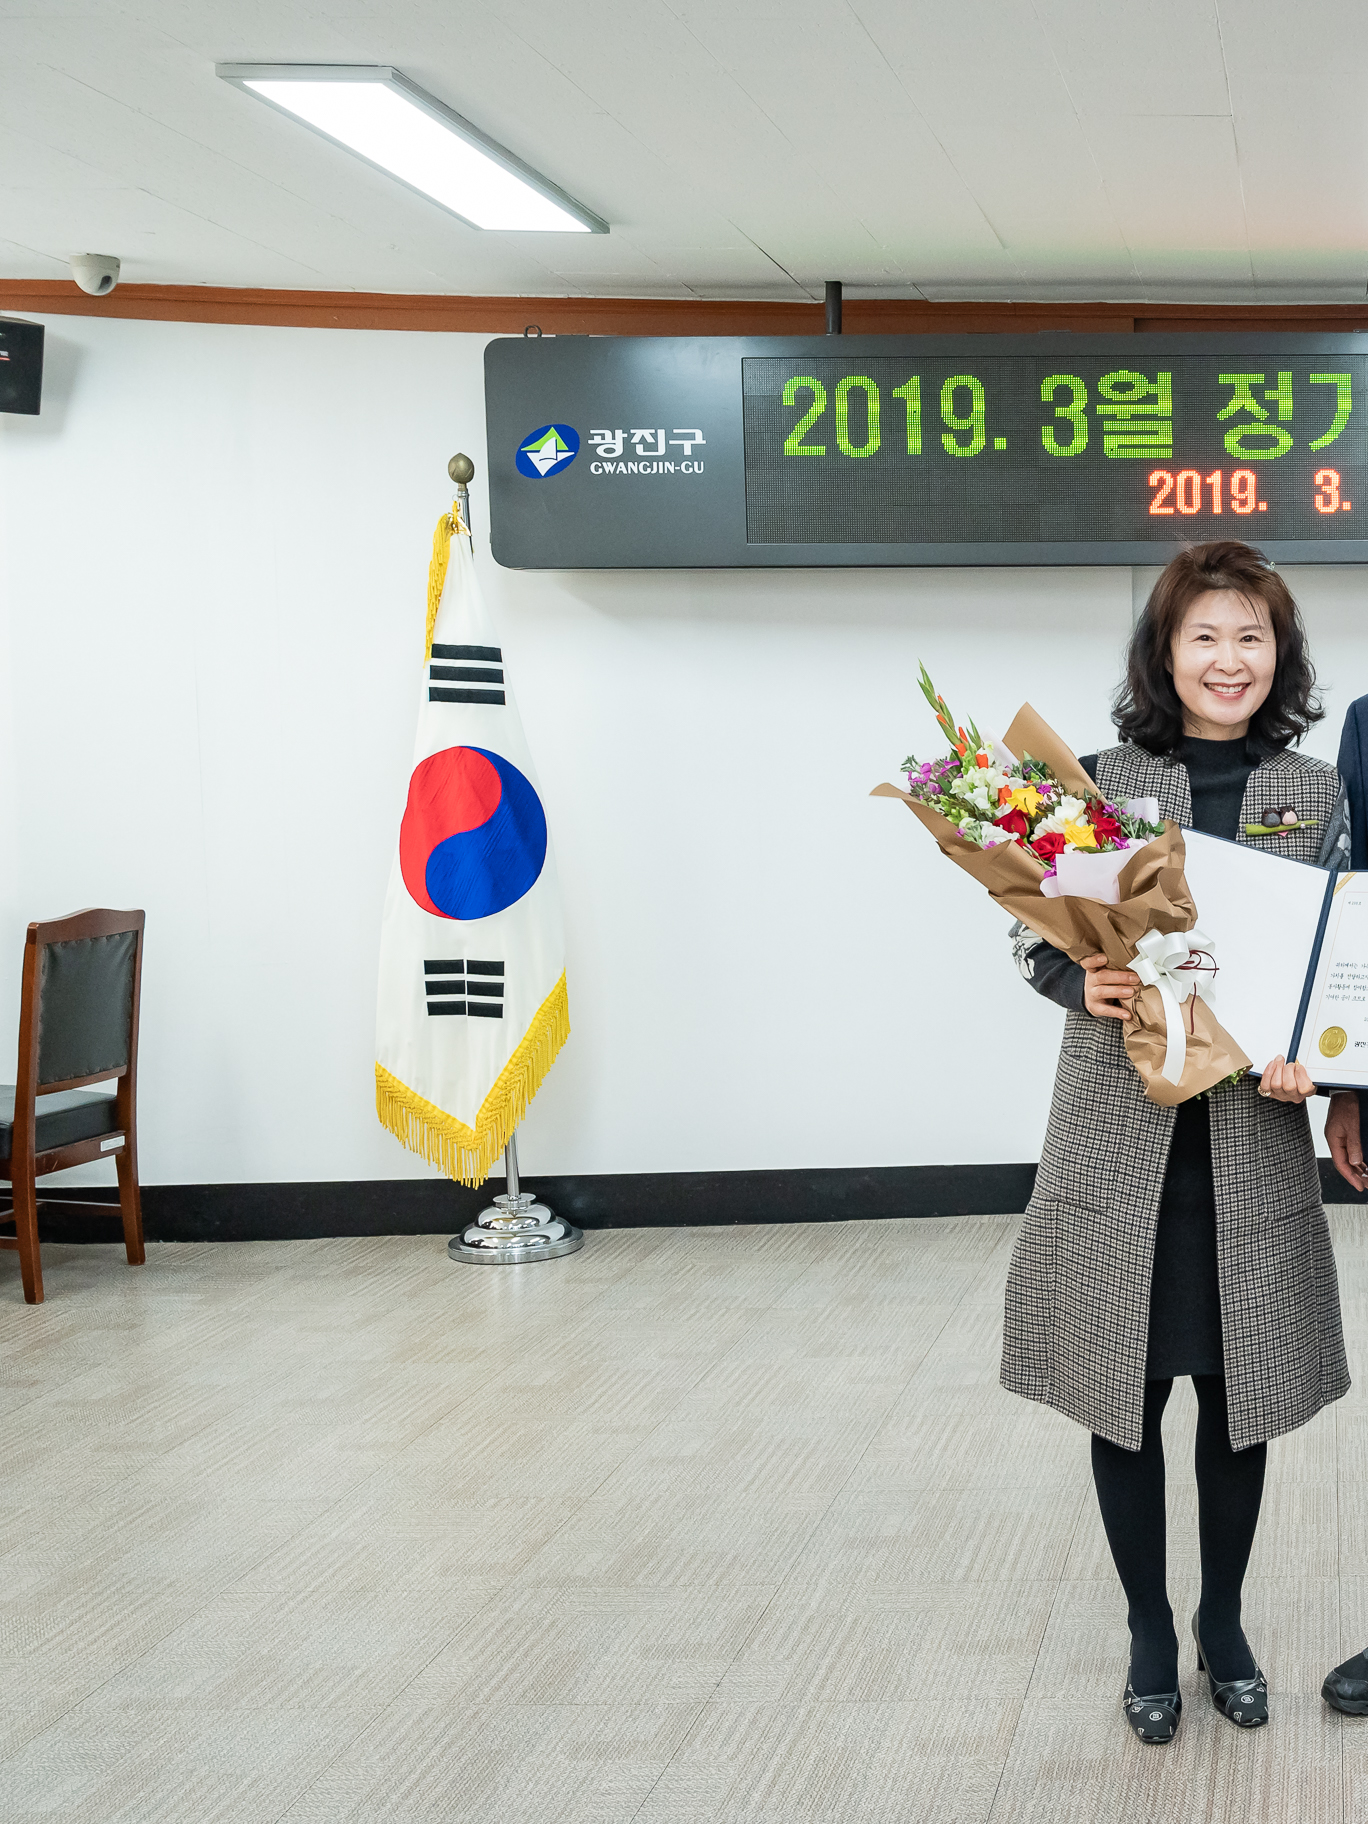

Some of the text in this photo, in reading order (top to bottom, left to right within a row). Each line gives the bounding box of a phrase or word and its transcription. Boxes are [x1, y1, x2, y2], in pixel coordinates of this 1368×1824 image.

[783, 374, 1007, 458] 2019.
[1040, 369, 1174, 459] 3월
[587, 428, 707, 460] 광진구
[589, 460, 705, 475] GWANGJIN-GU
[1147, 468, 1269, 516] 2019.
[1313, 467, 1352, 514] 3.
